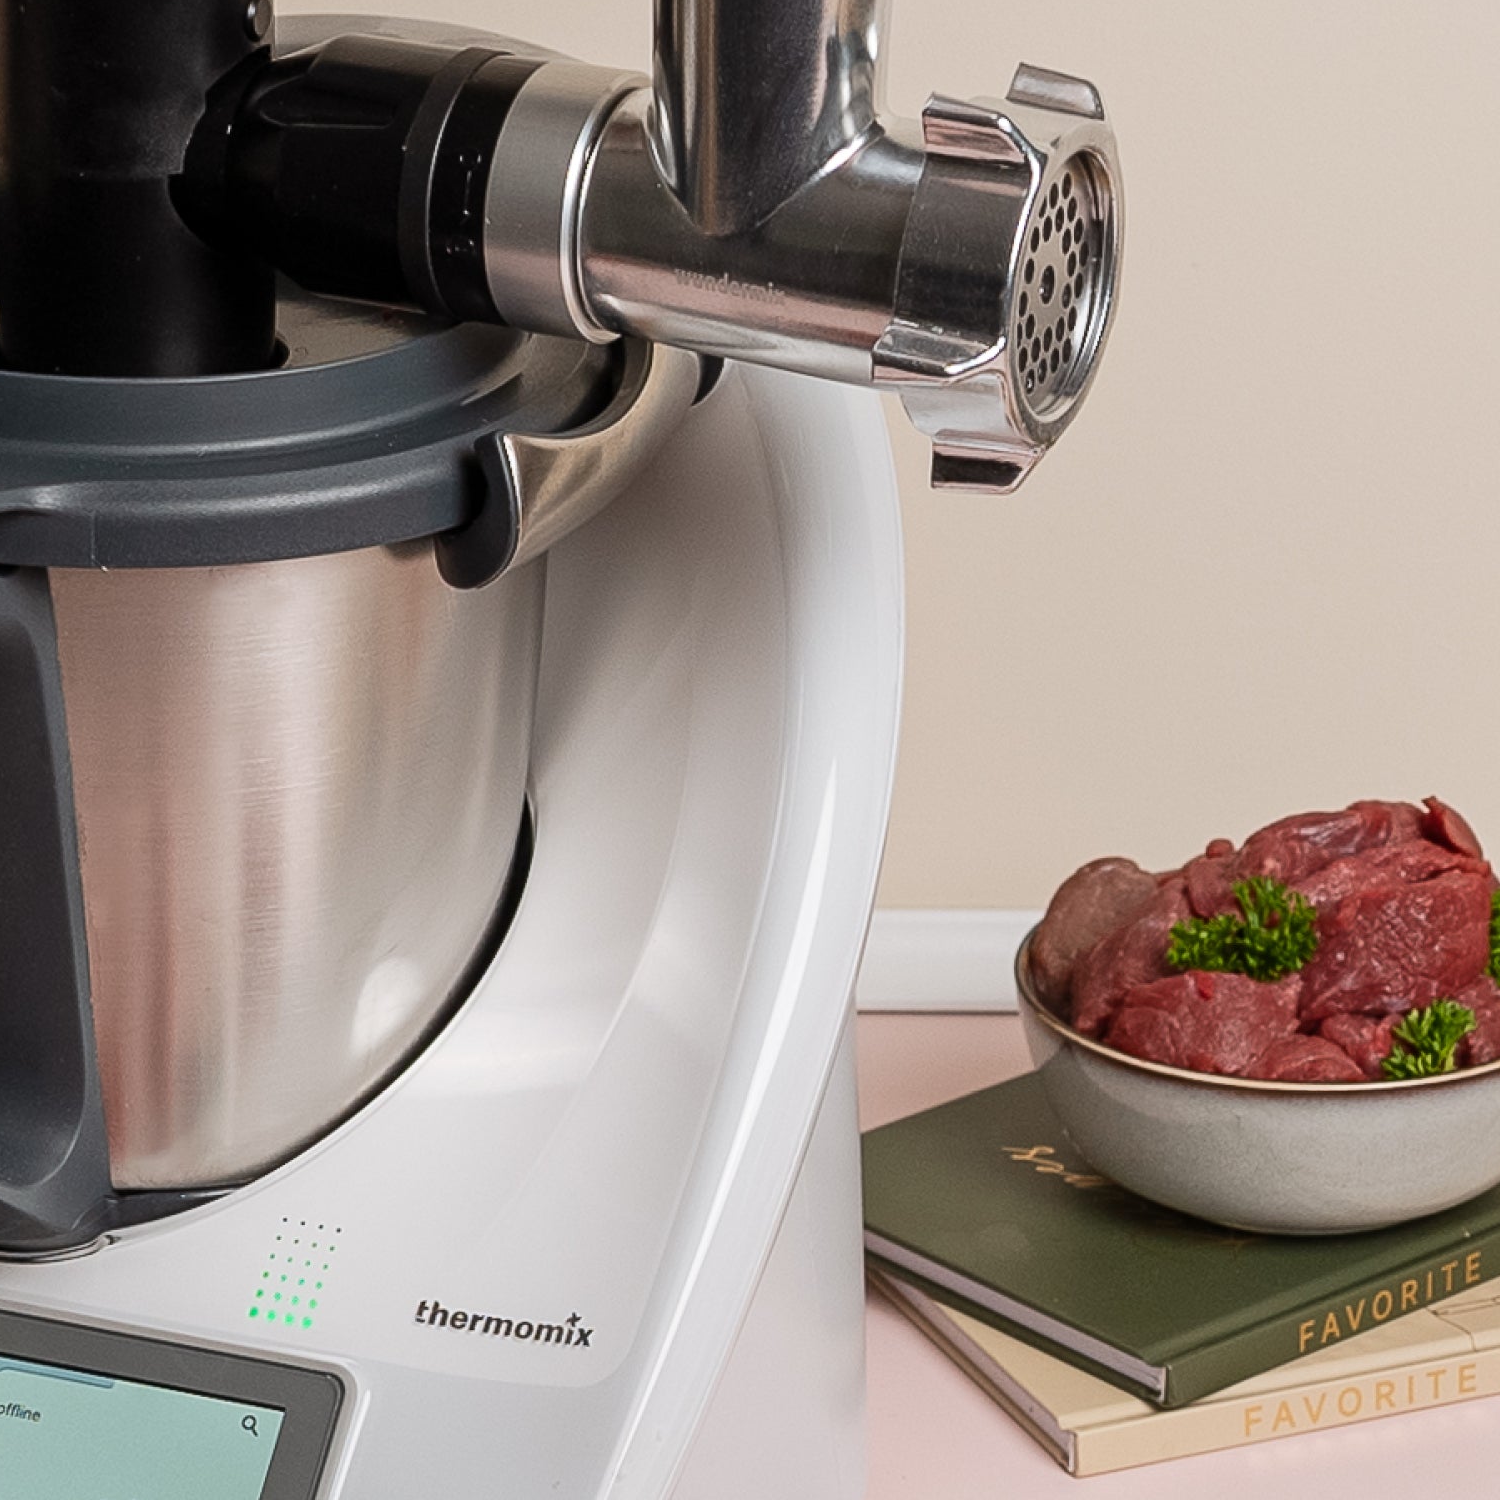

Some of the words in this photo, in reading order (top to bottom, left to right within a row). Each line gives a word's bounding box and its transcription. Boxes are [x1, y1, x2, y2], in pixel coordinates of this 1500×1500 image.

[674, 268, 786, 305] wundermix
[414, 1299, 594, 1347] thermomix
[1299, 1251, 1483, 1353] FAVORITE
[1243, 1363, 1479, 1437] FAVORITE
